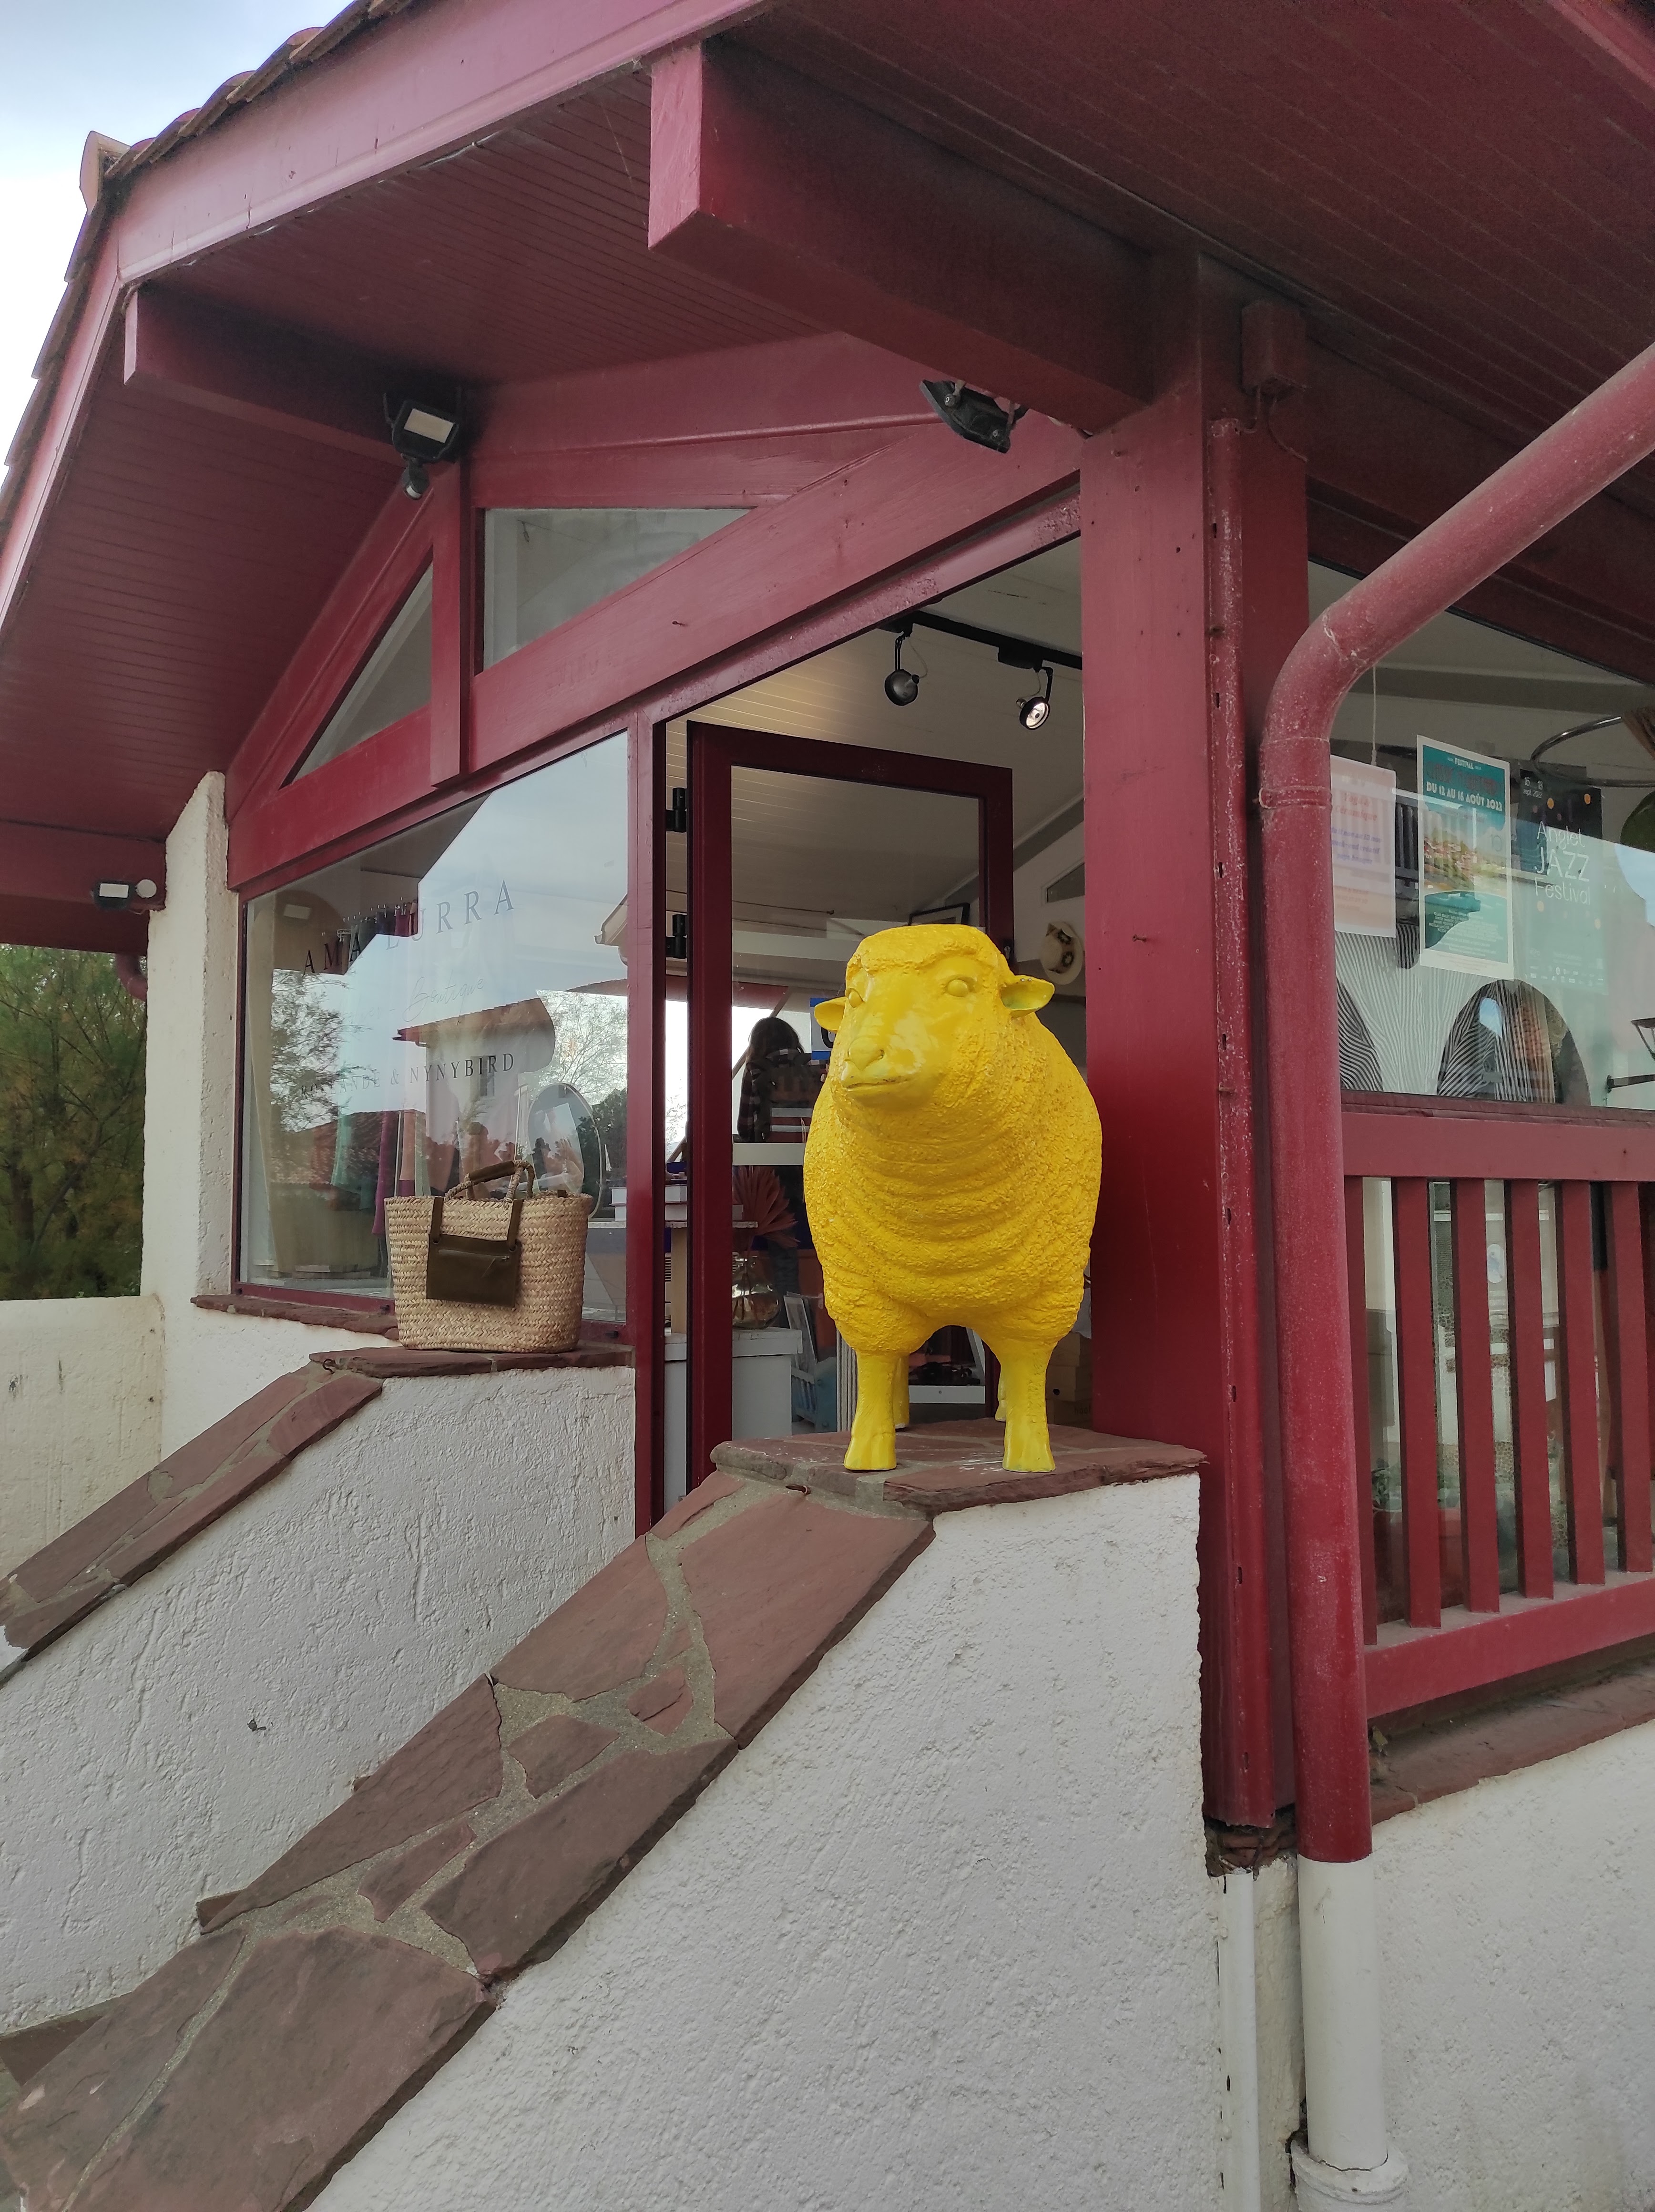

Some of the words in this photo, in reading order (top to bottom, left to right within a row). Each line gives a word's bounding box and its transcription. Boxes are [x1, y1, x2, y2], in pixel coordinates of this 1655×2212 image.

[1454, 758, 1474, 770] FESTIVAL
[1427, 781, 1437, 794] DU
[1439, 785, 1445, 796] 12
[1447, 788, 1456, 799] AU
[1466, 793, 1485, 806] AOÛT
[1486, 799, 1502, 812] 2022
[1537, 821, 1585, 850] Anglet
[1536, 847, 1589, 882] JAZZ
[1534, 876, 1590, 905] Festival
[402, 969, 484, 1023] Boutique
[390, 1068, 399, 1086] &
[409, 1053, 514, 1084] NYNYBIRD
